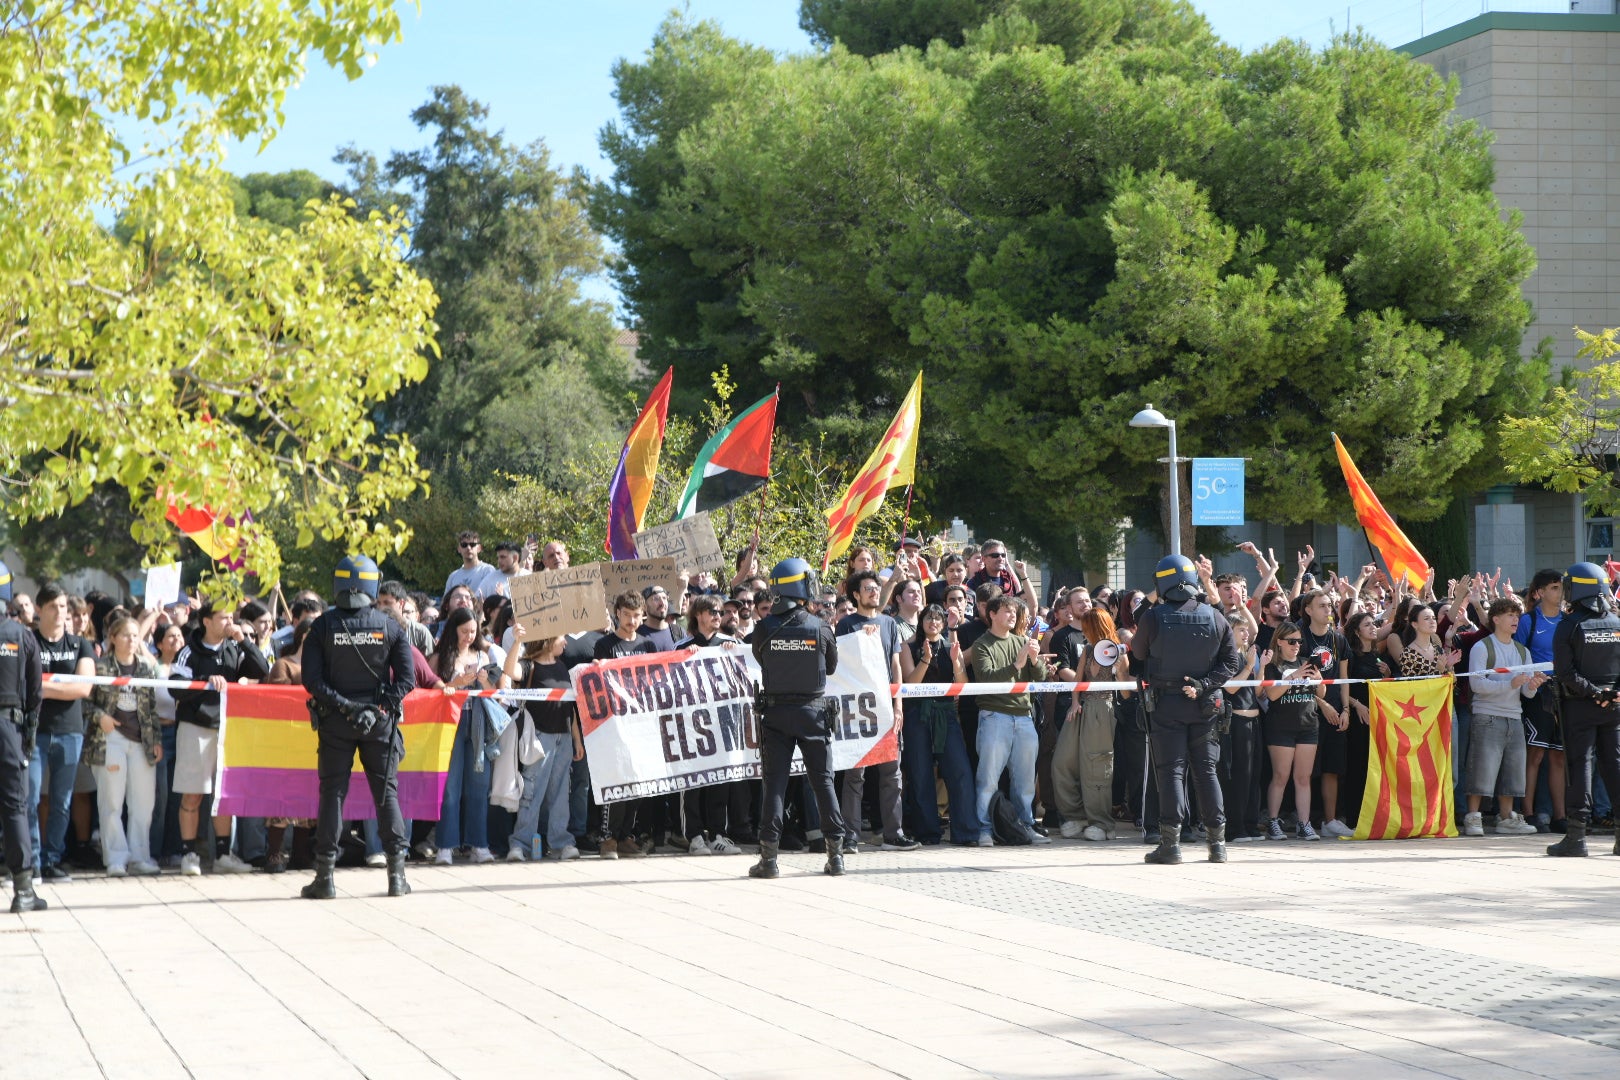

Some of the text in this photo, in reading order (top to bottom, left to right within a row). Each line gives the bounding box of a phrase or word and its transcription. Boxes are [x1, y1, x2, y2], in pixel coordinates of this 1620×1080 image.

[611, 564, 654, 574] FASCISMO
[572, 608, 589, 620] UA
[334, 632, 373, 640] POLICIA
[580, 655, 755, 721] COMBATEM
[658, 708, 718, 763] ELS
[603, 780, 656, 801] ACABEM
[656, 776, 687, 793] AMB
[687, 773, 705, 788] LA
